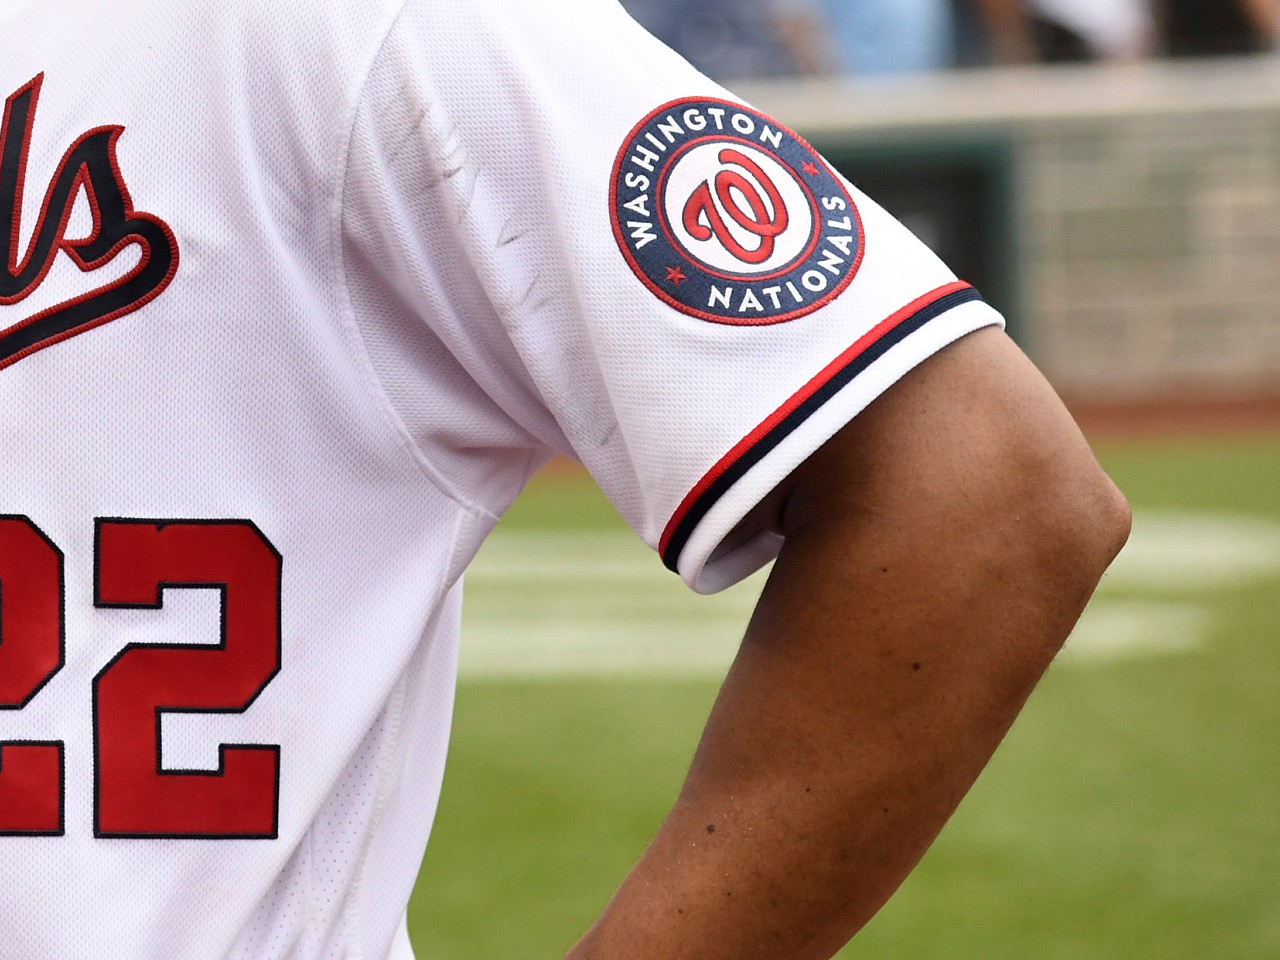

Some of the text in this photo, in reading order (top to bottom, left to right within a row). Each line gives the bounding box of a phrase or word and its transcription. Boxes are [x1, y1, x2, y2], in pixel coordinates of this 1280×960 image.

[623, 107, 783, 250] WASHINGTON
[682, 148, 789, 265] W
[708, 195, 853, 313] NATIONALS
